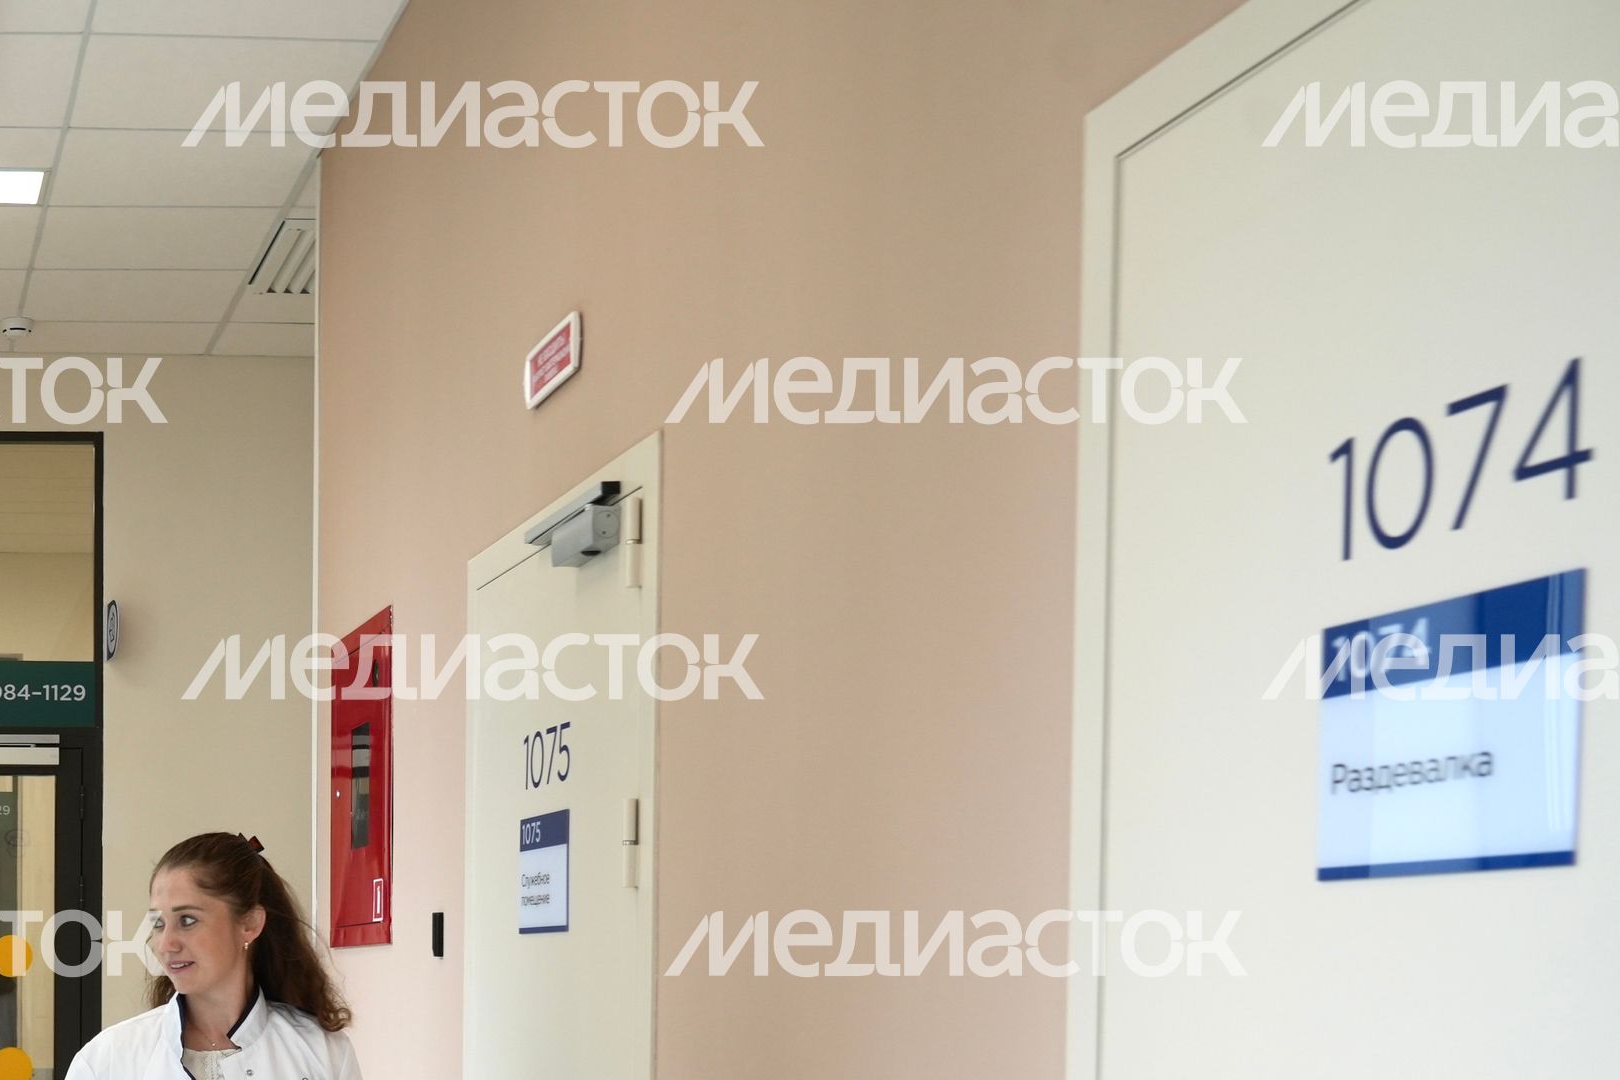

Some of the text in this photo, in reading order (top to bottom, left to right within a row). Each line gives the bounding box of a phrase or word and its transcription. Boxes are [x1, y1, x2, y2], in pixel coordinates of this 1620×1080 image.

[1330, 357, 1594, 560] 1074
[1333, 618, 1430, 682] 1074
[524, 721, 571, 790] 1075
[1332, 751, 1492, 794] Раздевалка
[522, 821, 541, 845] 1075
